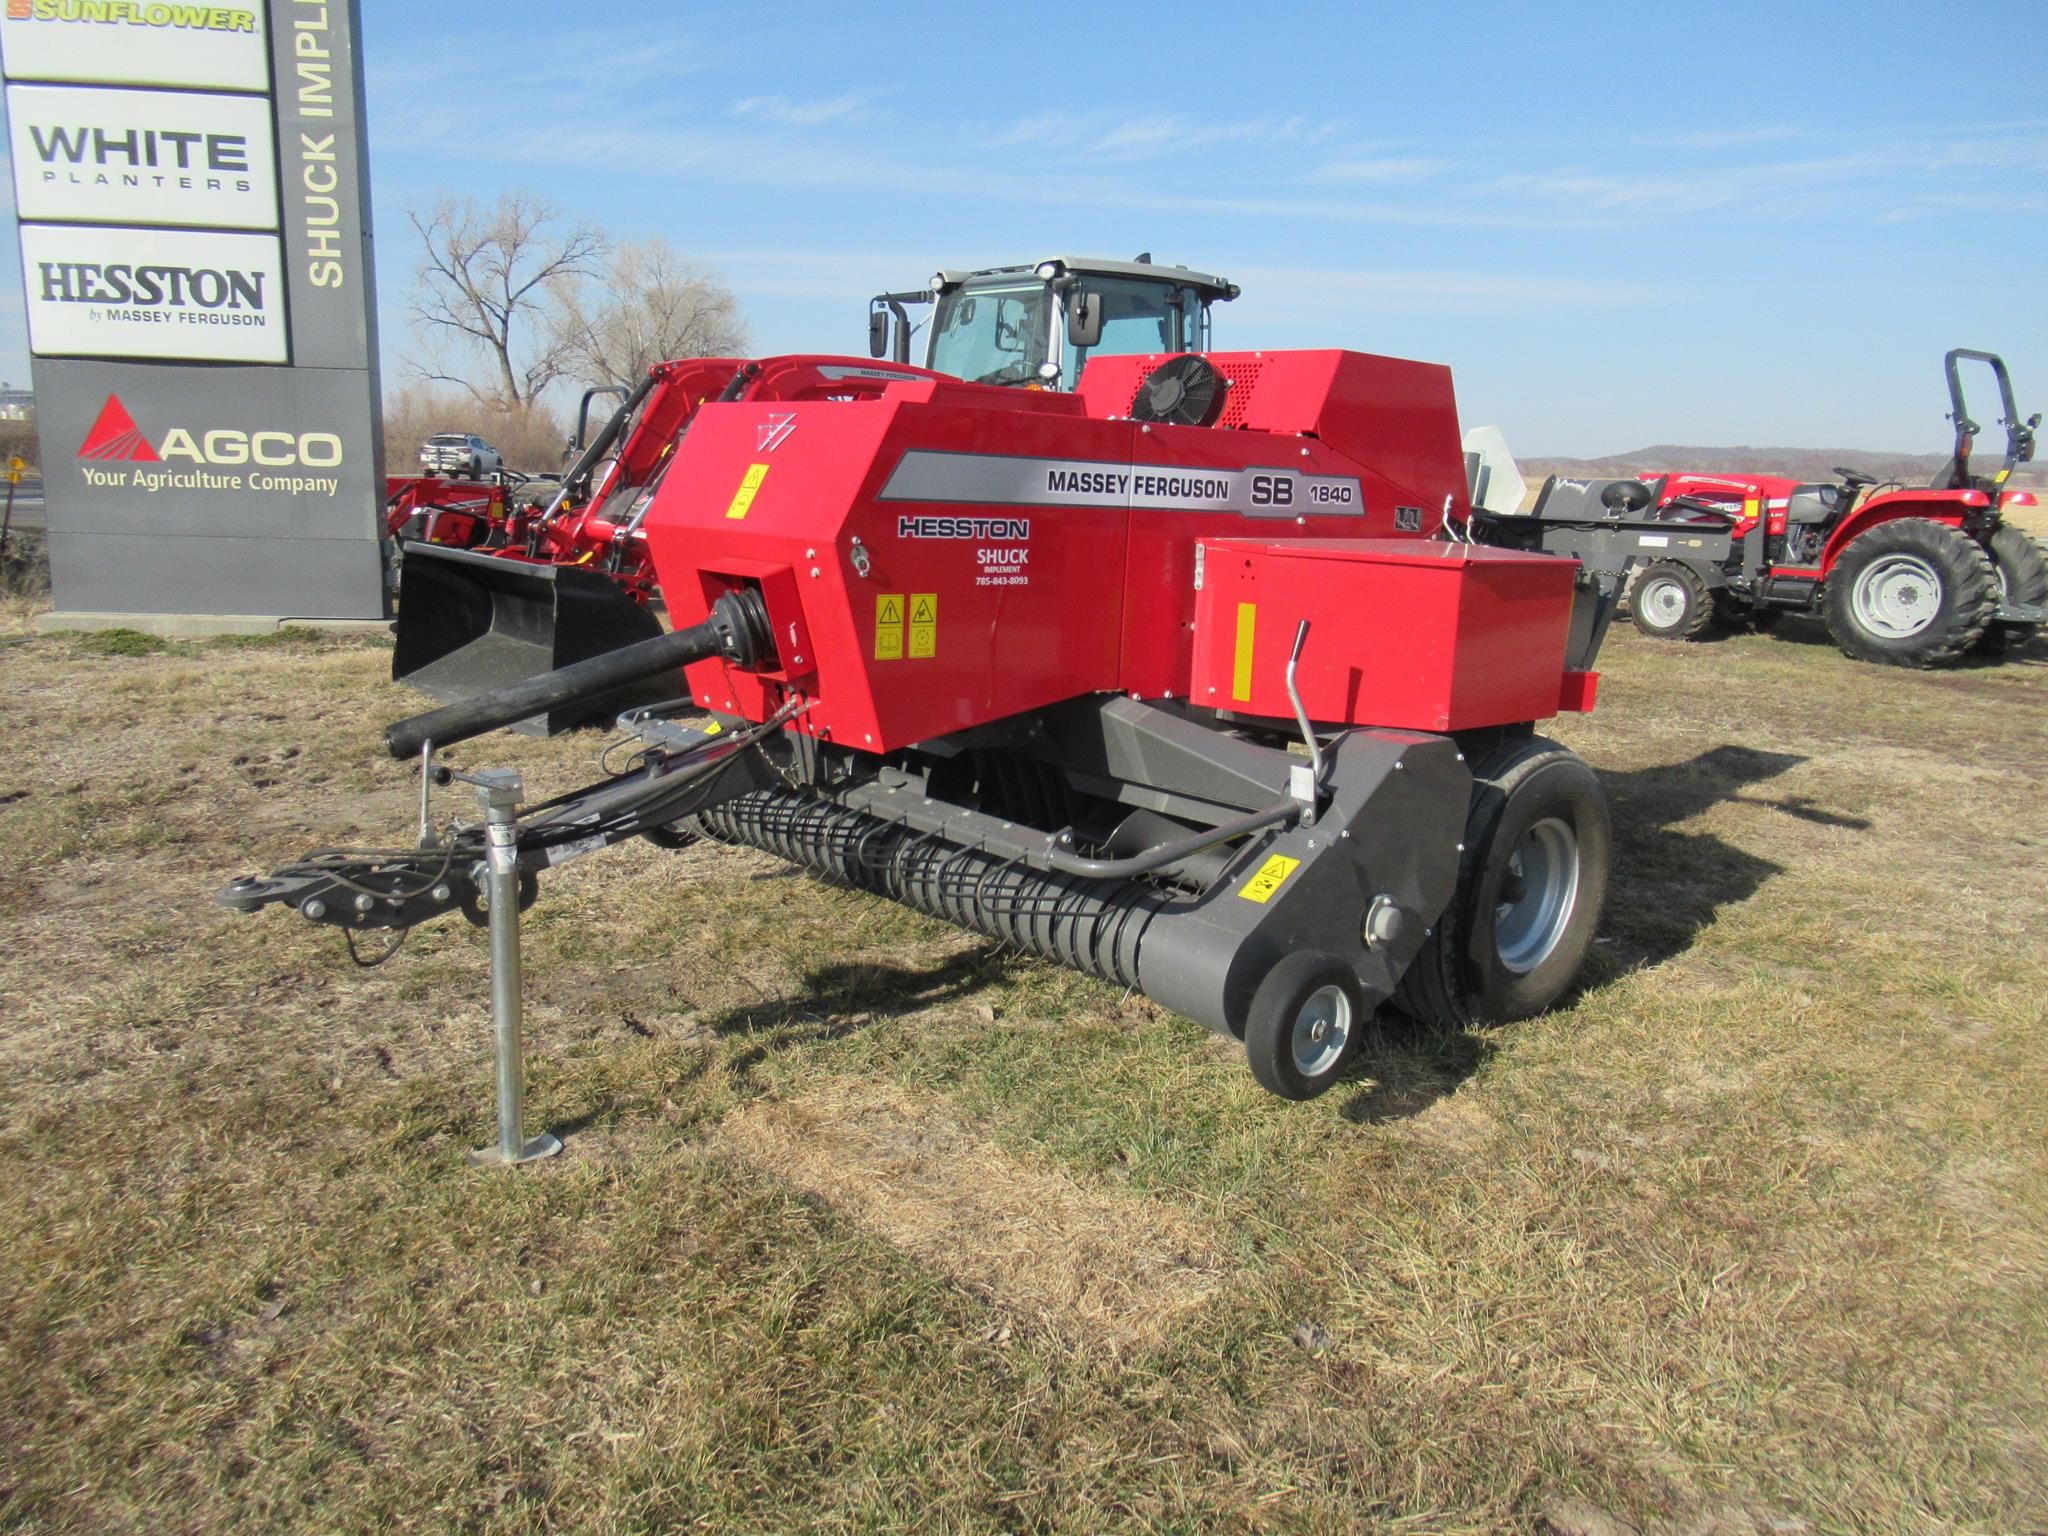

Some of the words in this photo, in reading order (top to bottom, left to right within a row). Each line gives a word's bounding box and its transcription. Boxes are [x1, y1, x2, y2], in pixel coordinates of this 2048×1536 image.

[33, 0, 256, 33] SUNFLOWER
[293, 0, 334, 117] IMPL
[29, 125, 249, 172] WHITE
[42, 171, 251, 192] PLANTERS
[301, 133, 344, 288] SHUCK
[37, 262, 266, 310] HESSTON
[89, 309, 104, 324] by
[106, 308, 172, 323] MASSEY
[178, 312, 266, 326] FERGUSON
[860, 369, 885, 378] MASSEY
[158, 428, 343, 467] AGCO
[82, 468, 127, 487] Your
[133, 470, 242, 492] Agriculture
[248, 472, 339, 497] Company
[1048, 470, 1129, 495] MASSEY
[1133, 475, 1230, 499] FERGUSON
[1251, 475, 1295, 506] SB
[1309, 485, 1352, 503] 1840
[898, 515, 1030, 540] HESSTON
[976, 548, 1029, 565] SHUCK
[983, 565, 1022, 574] IMPLEMENT
[975, 576, 1029, 586] 785-843-8093
